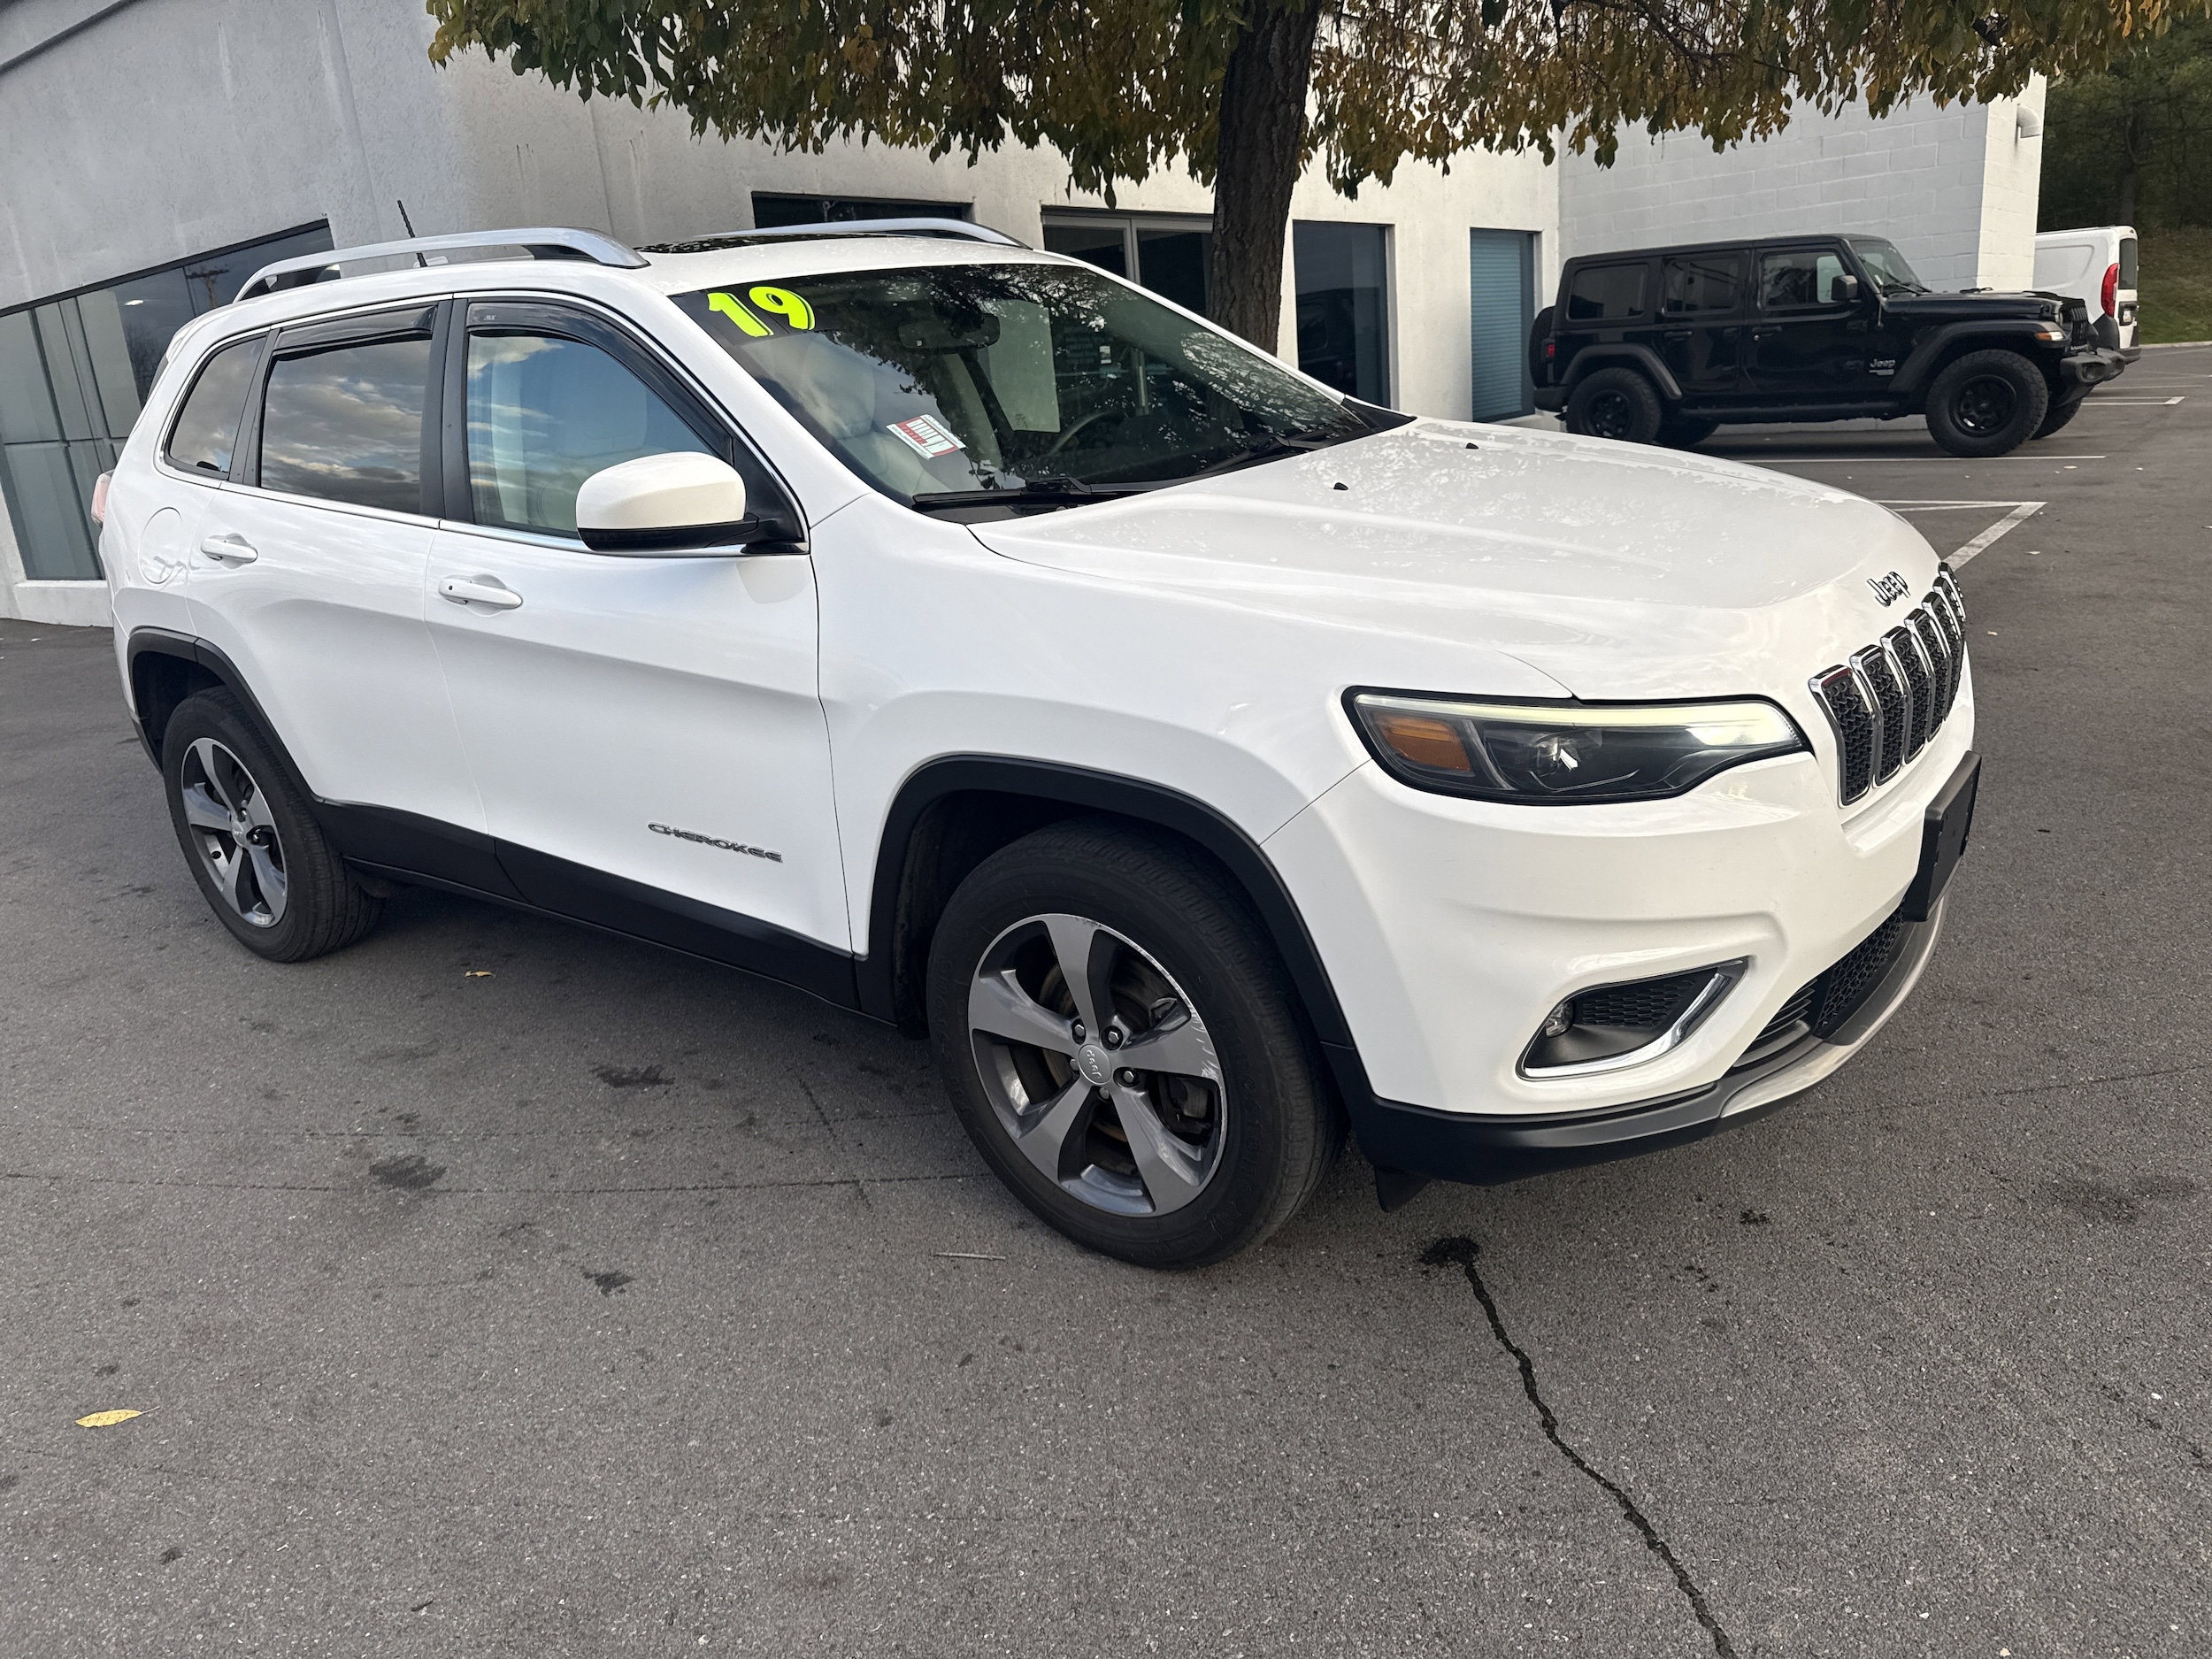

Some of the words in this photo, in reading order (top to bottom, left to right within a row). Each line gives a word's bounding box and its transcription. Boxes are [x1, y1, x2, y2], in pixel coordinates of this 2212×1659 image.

[707, 286, 816, 337] 19
[1870, 358, 1895, 368] Jeep
[1866, 571, 1910, 608] Jeep
[648, 822, 783, 863] CHEROKEE
[1087, 1049, 1102, 1079] Jeep
